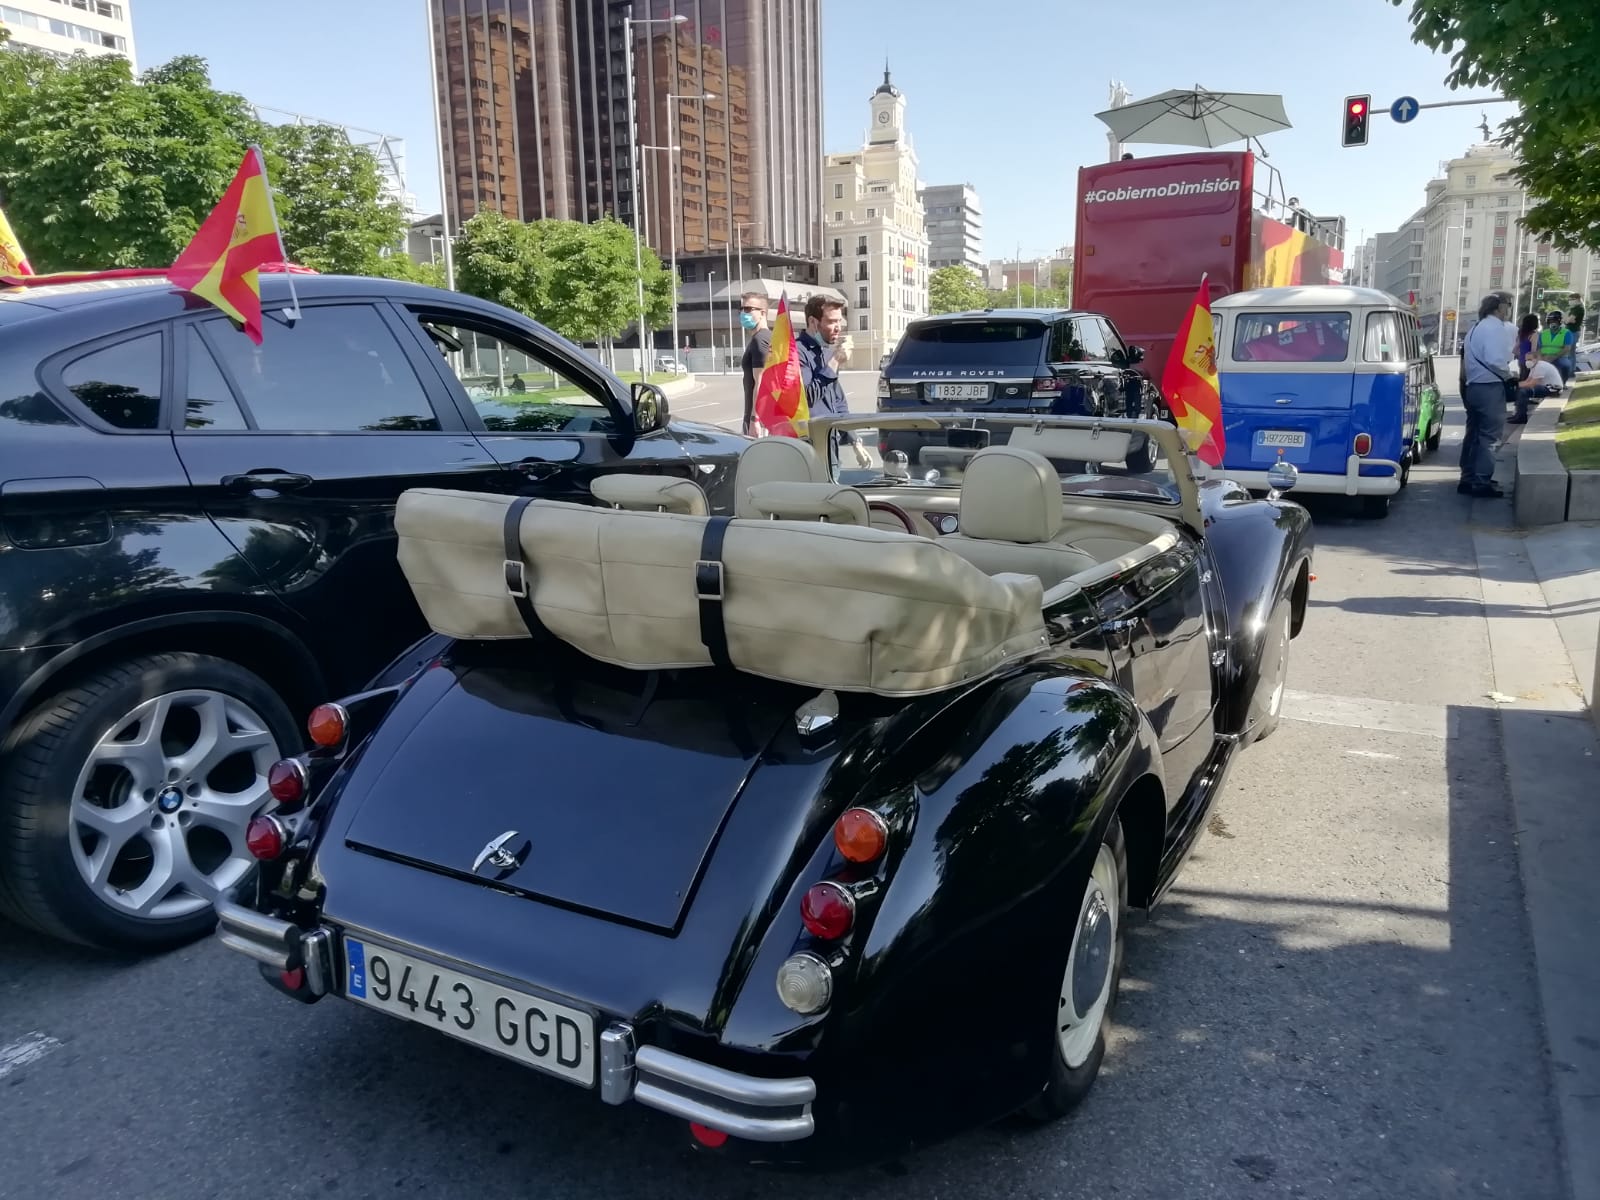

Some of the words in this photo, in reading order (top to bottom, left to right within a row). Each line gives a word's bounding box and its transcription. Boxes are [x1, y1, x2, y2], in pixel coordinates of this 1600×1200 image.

[1084, 178, 1240, 203] #GobiernoDimisión
[937, 385, 963, 397] 1832
[966, 385, 987, 397] JBF
[370, 955, 475, 1030] 9443
[495, 997, 581, 1069] GGD
